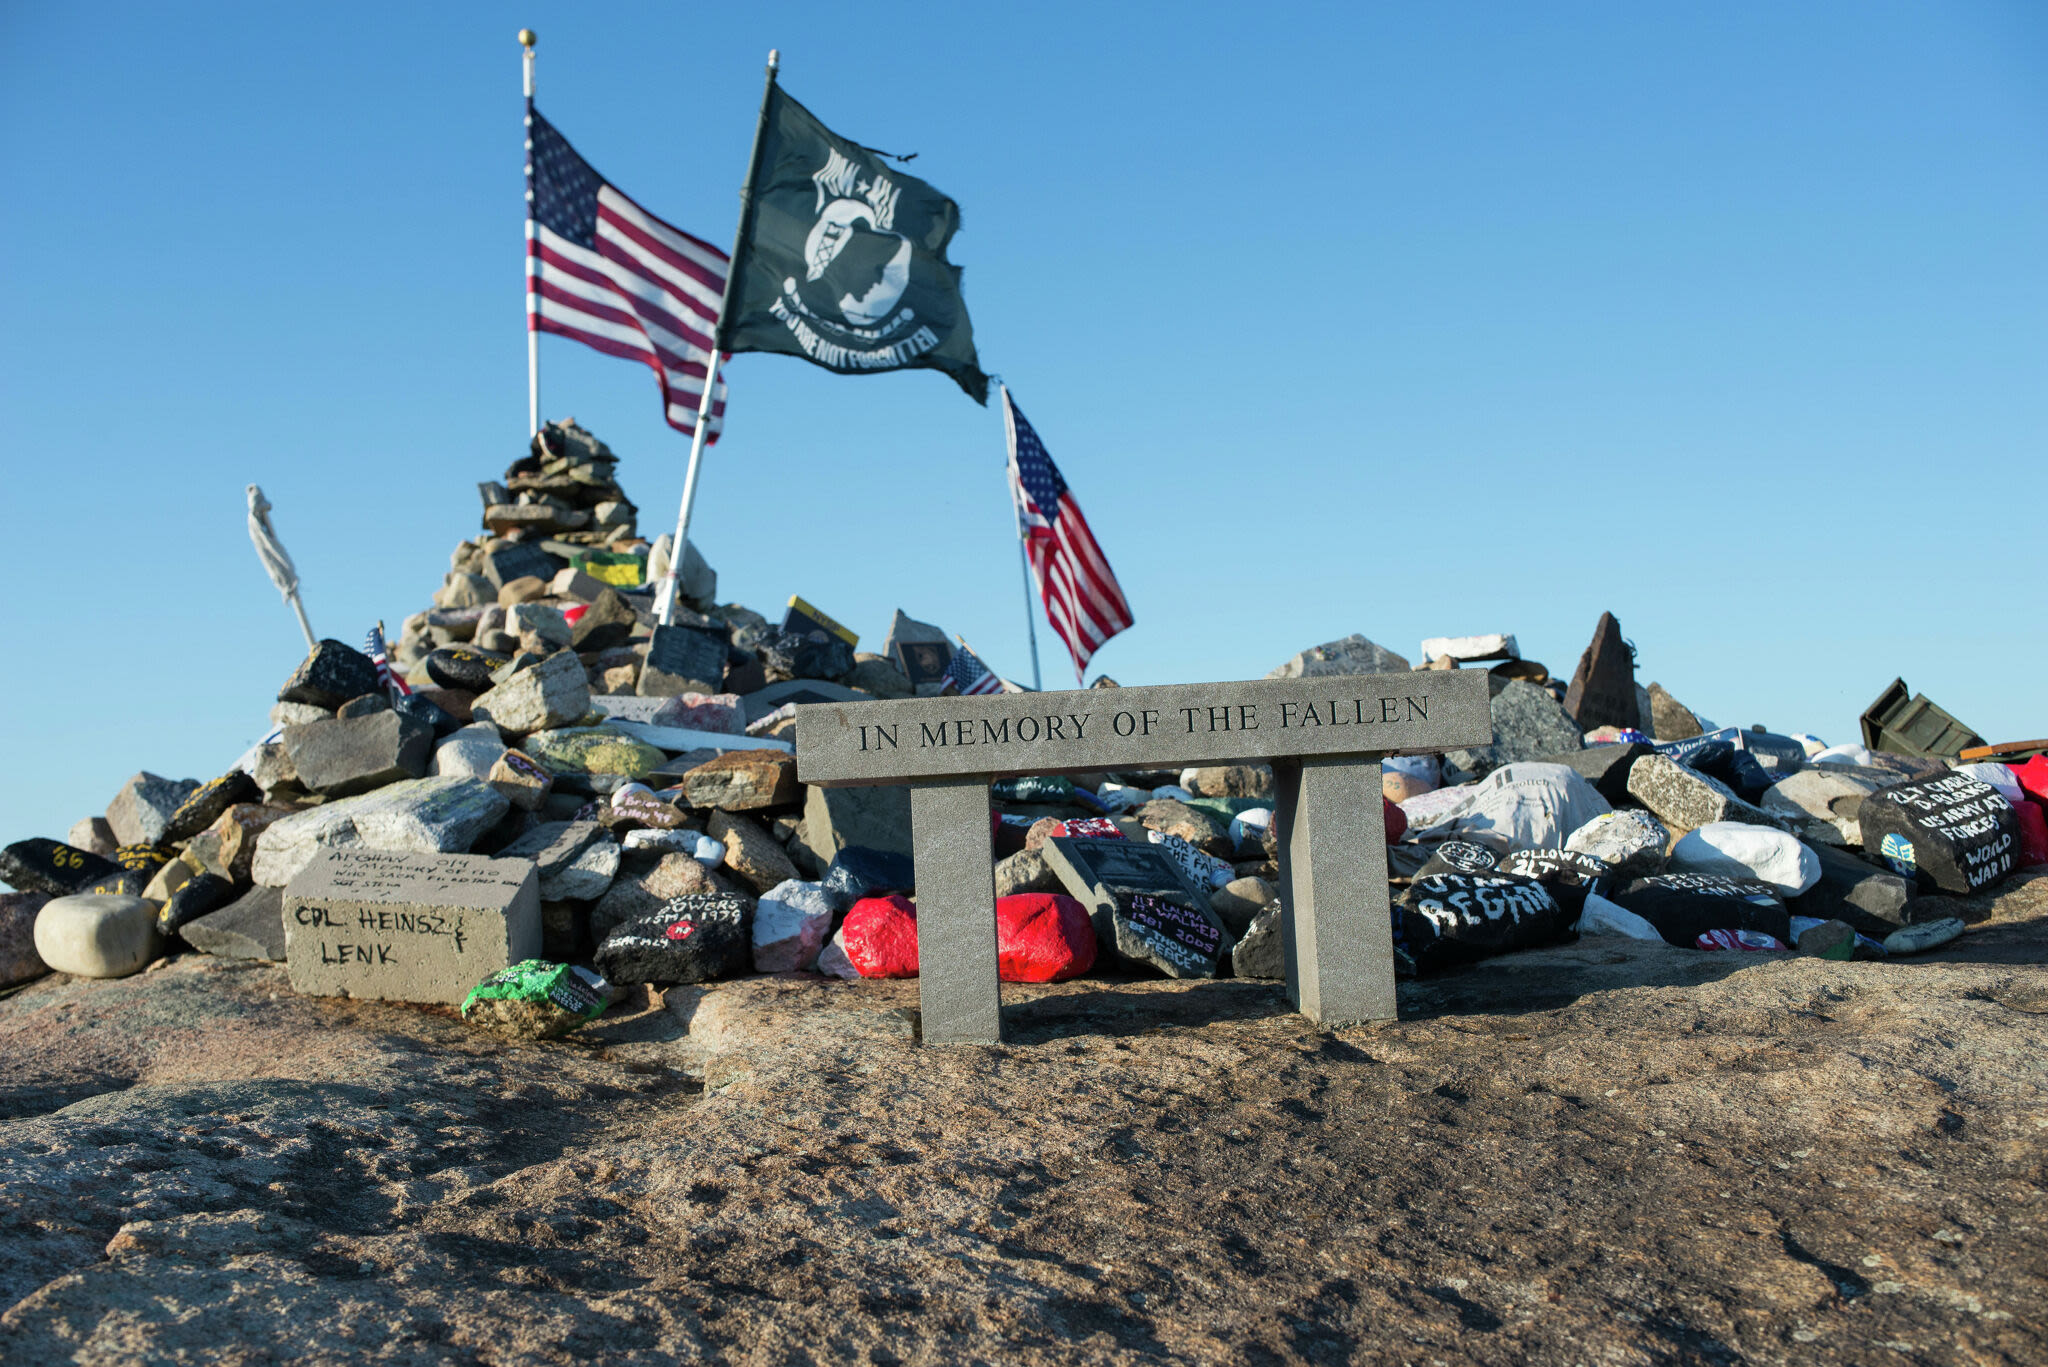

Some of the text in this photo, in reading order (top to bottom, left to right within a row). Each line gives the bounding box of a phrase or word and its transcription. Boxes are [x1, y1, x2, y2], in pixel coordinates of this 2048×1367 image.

[768, 295, 940, 370] YOU ARE NOT FORGOTTEN
[858, 695, 1431, 751] IN MEMORY OF THE FALLEN
[1918, 815, 1946, 828] US
[1942, 801, 1986, 823] ARMY
[1940, 814, 2000, 841] FORCES
[1510, 848, 1575, 862] FOLLOW
[1966, 833, 2012, 866] WORLD
[1968, 853, 2012, 887] WAR II
[1156, 908, 1220, 941] WALKER
[320, 942, 398, 965] LENK
[1128, 921, 1209, 965] BE THOU AT
[1145, 937, 1193, 970] PEACE
